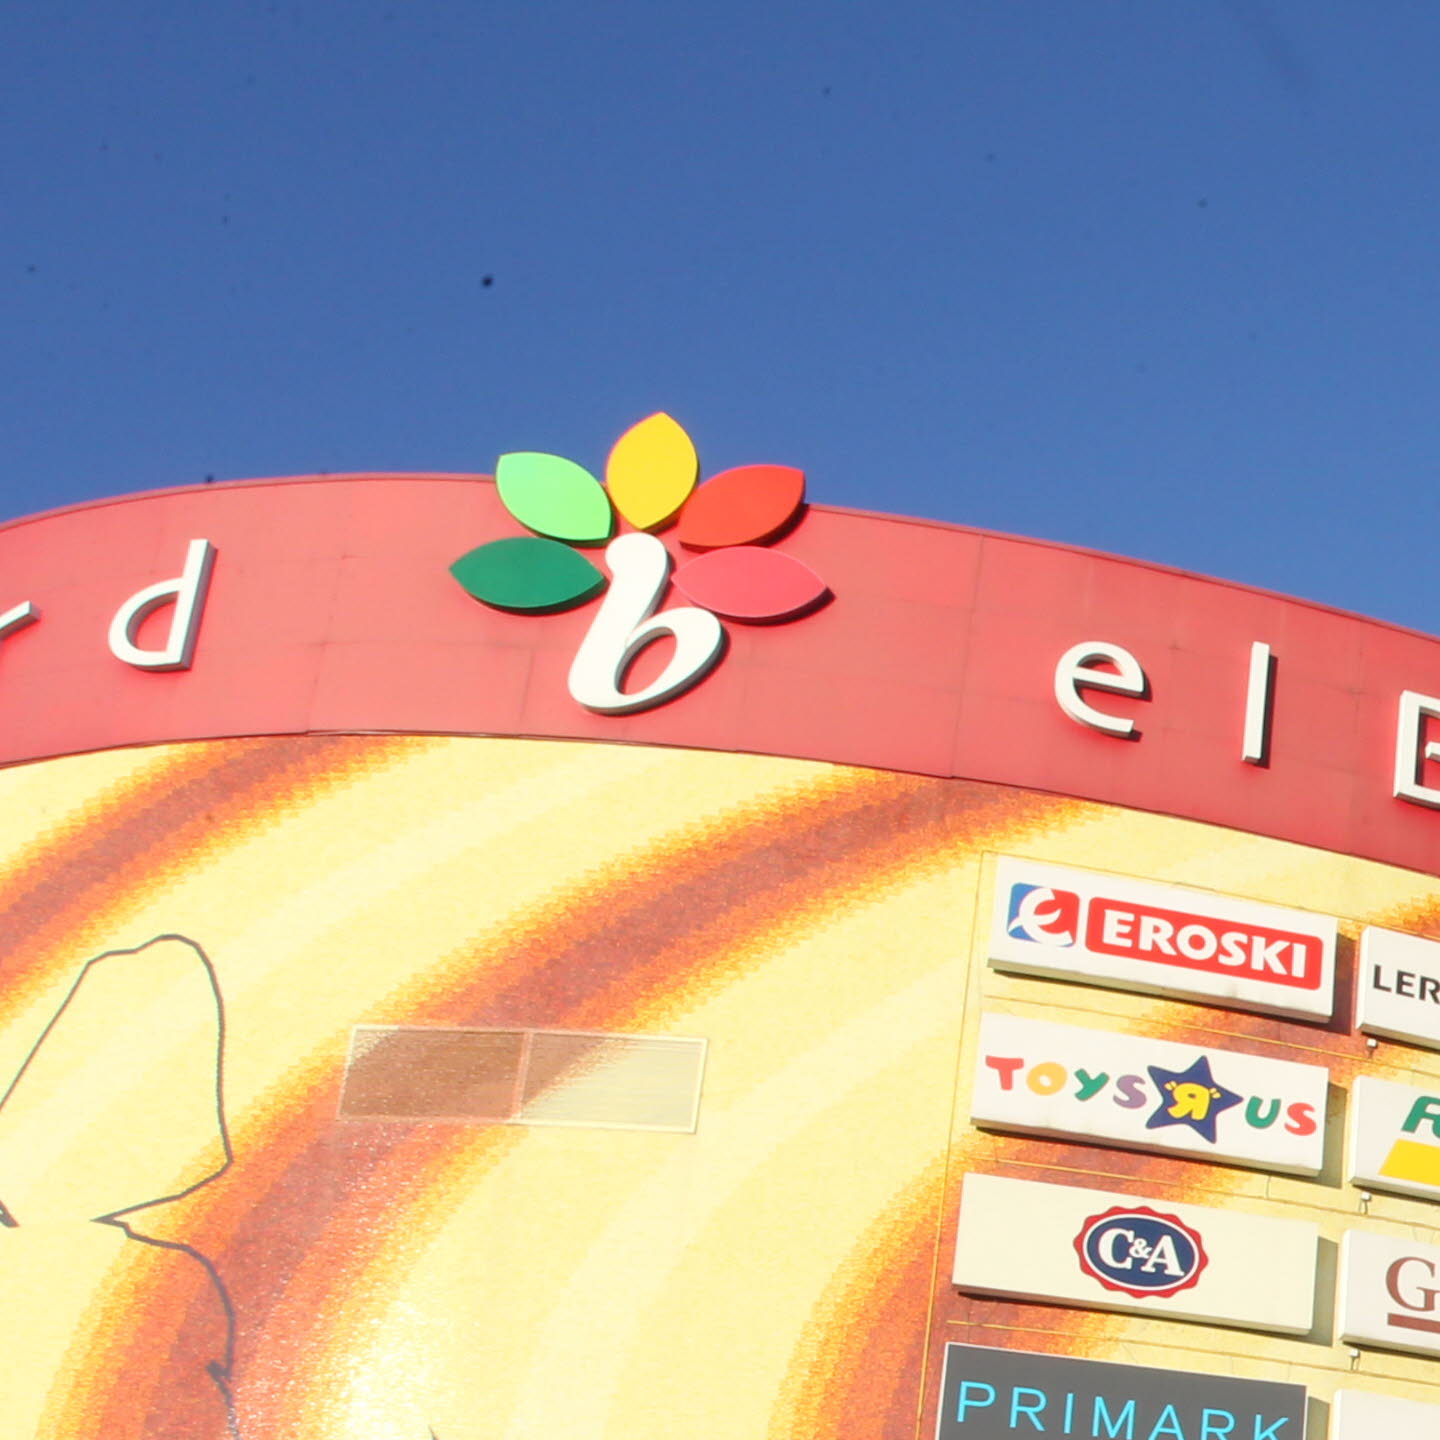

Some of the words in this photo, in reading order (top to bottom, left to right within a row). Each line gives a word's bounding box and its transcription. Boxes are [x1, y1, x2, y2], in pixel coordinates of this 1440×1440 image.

[1102, 908, 1308, 979] EROSKI
[985, 1055, 1148, 1110] TOYS
[1245, 1095, 1318, 1137] US
[1098, 1227, 1185, 1277] C&A
